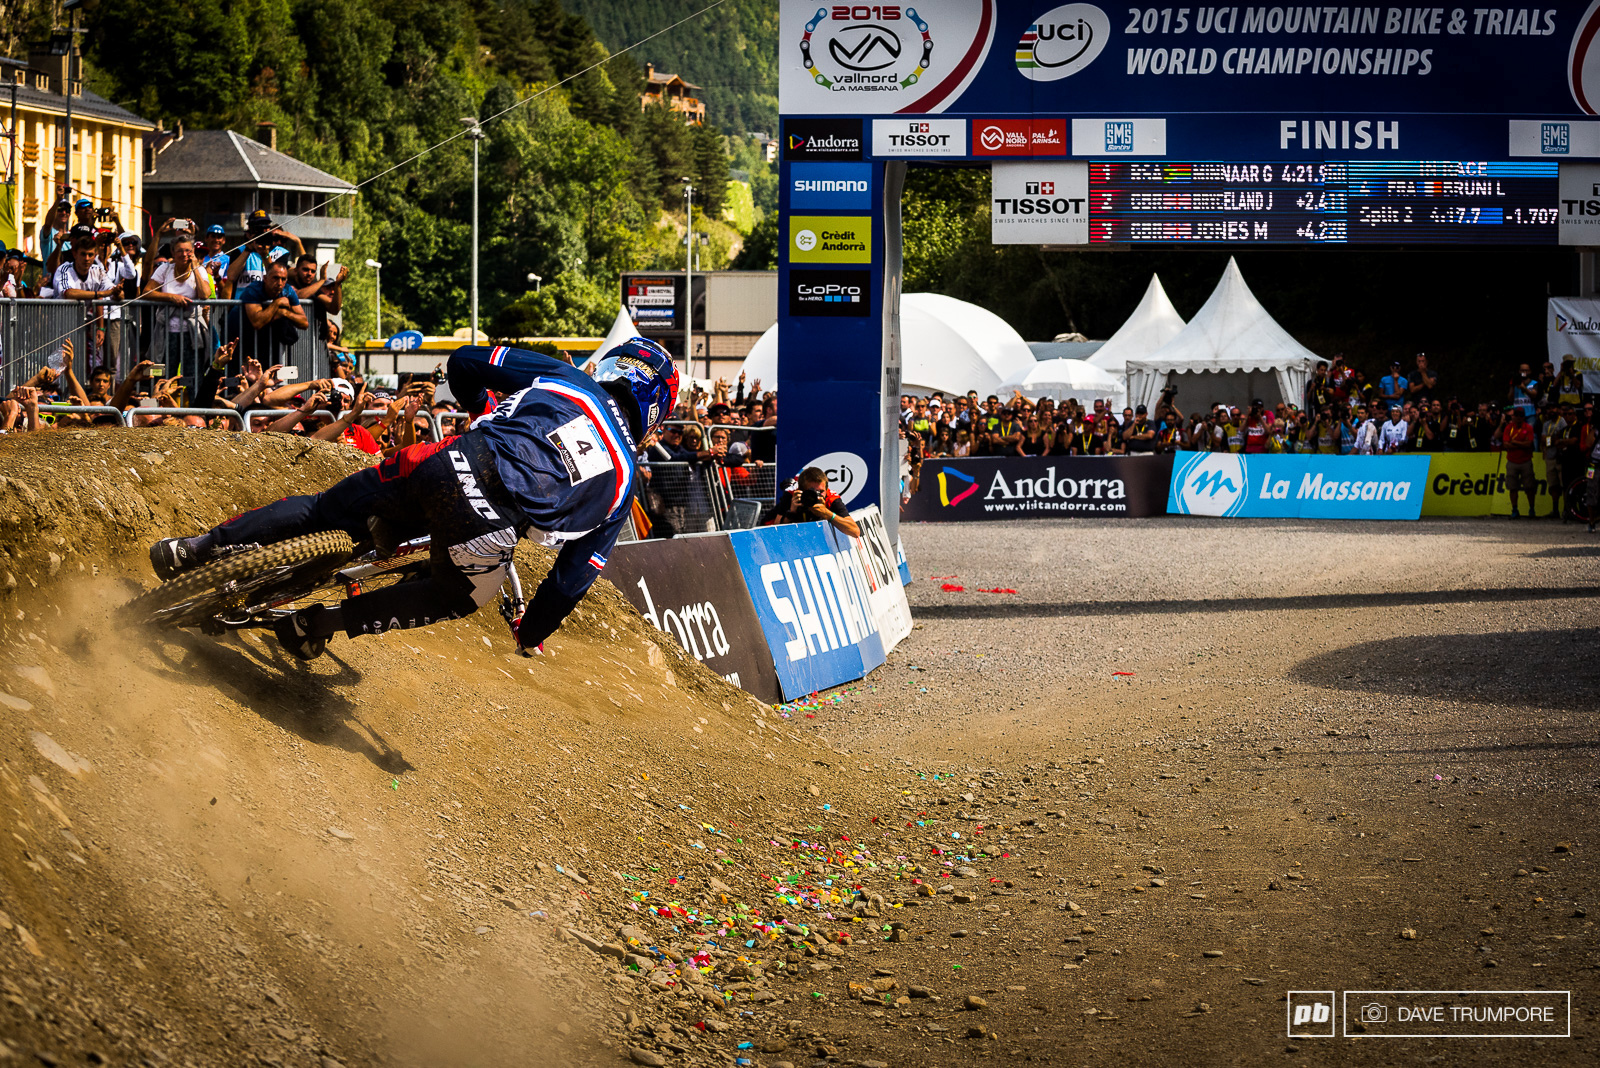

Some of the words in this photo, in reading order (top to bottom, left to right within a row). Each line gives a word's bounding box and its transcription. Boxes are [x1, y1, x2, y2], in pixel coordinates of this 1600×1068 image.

[831, 5, 901, 20] 2015
[1125, 8, 1189, 35] 2015
[1196, 8, 1240, 35] UCI
[1241, 8, 1378, 35] MOUNTAIN
[1384, 9, 1442, 35] BIKE
[1447, 9, 1467, 35] &
[1473, 9, 1556, 36] TRIALS
[1127, 48, 1217, 75] WORLD
[1223, 48, 1433, 76] CHAMPIONSHIPS
[833, 73, 897, 84] vallnord
[806, 134, 859, 148] Andorra
[889, 135, 950, 146] TISSOT
[1280, 121, 1399, 149] FINISH
[1263, 165, 1272, 182] G
[794, 180, 867, 192] SHIMANO
[1496, 181, 1505, 195] L
[994, 198, 1085, 214] TISSOT
[1265, 192, 1273, 210] J
[1506, 208, 1558, 224] -1.707
[821, 230, 855, 240] Crèdit
[1254, 221, 1268, 239] M
[821, 241, 865, 252] Andorrà
[798, 284, 860, 296] GoPro
[391, 336, 415, 352] elf
[607, 398, 637, 452] FRANCE
[576, 440, 593, 456] 4
[984, 466, 1126, 499] Andorra
[1259, 473, 1290, 500] La
[1296, 473, 1411, 501] Massana
[1432, 472, 1506, 496] Crèdit
[637, 576, 730, 661] dorra
